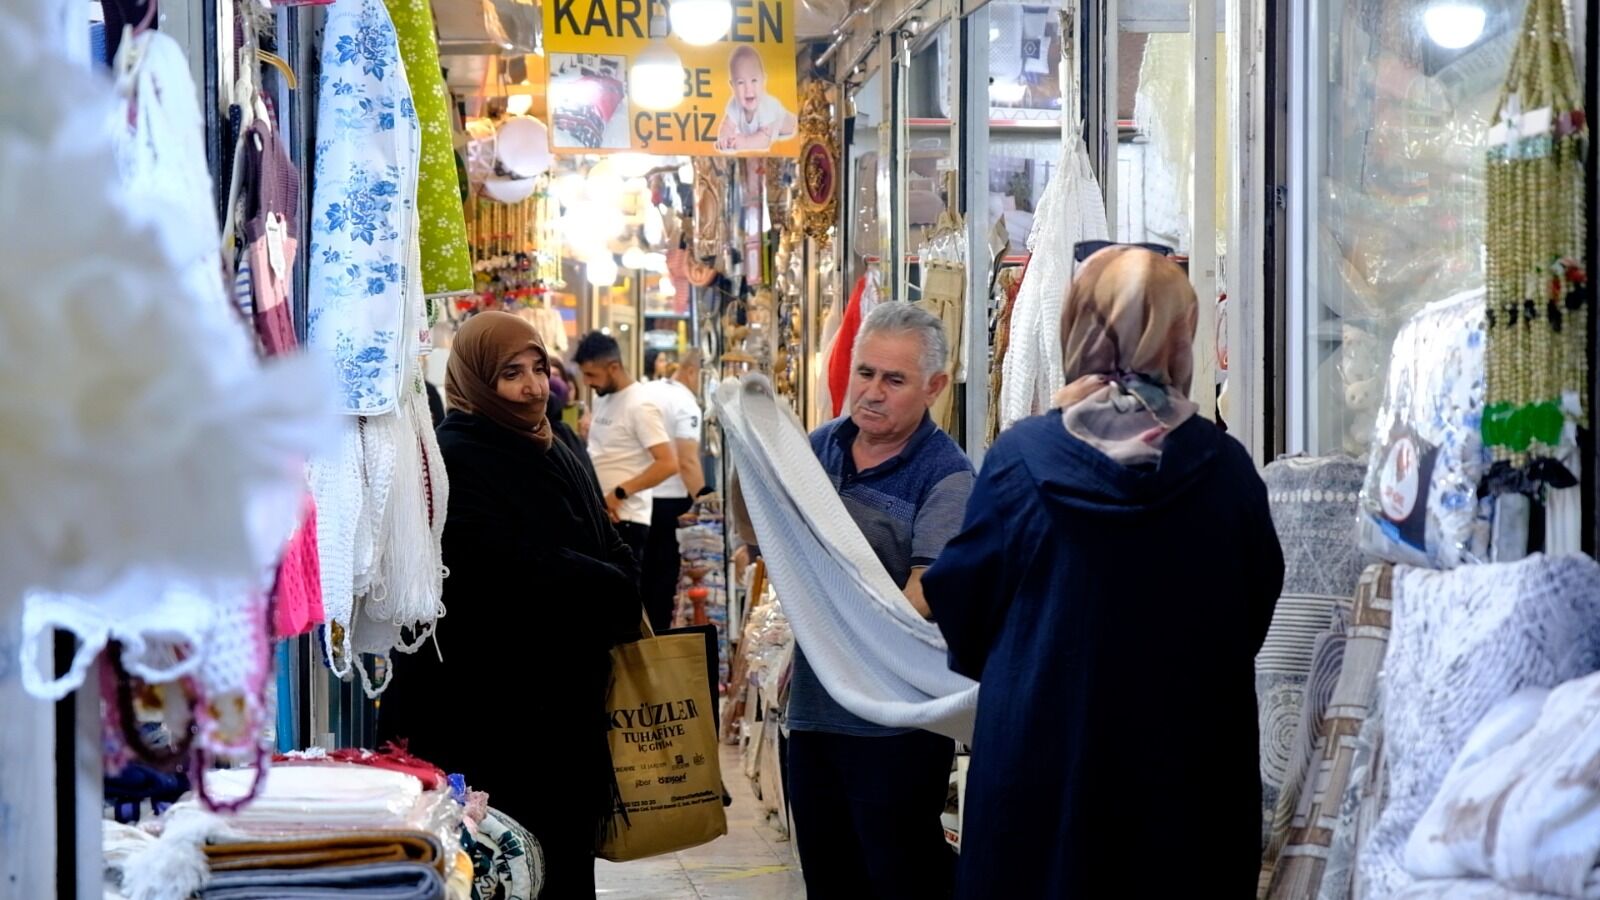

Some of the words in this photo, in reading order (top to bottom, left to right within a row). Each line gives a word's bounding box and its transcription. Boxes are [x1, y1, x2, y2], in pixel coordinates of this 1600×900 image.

[553, 0, 783, 43] KARDEN
[634, 105, 718, 149] ÇEYİZ
[622, 725, 685, 743] TUHAFİYE
